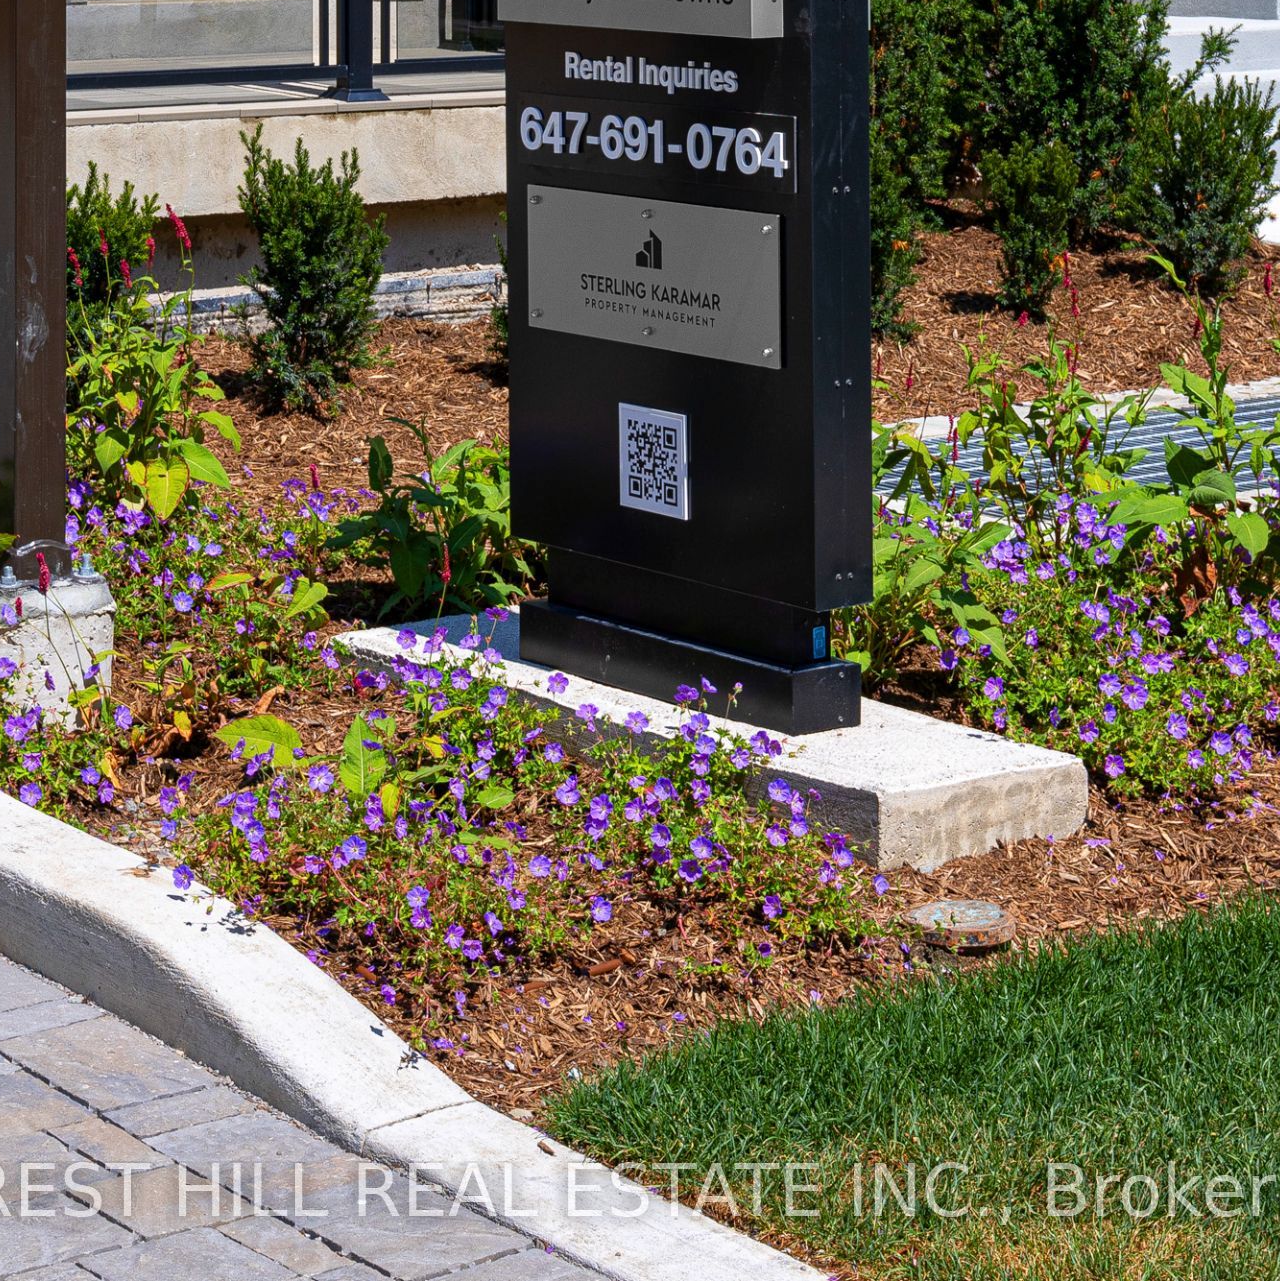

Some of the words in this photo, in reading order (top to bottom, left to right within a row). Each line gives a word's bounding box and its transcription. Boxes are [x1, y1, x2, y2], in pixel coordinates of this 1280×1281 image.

[564, 51, 633, 83] Rental
[639, 57, 738, 95] Inquiries
[520, 106, 788, 178] 647-691-0764
[581, 273, 646, 299] STERLING
[652, 284, 720, 311] KARAMAR
[585, 297, 637, 314] PROPERTY
[643, 308, 716, 328] MANAGEMENT
